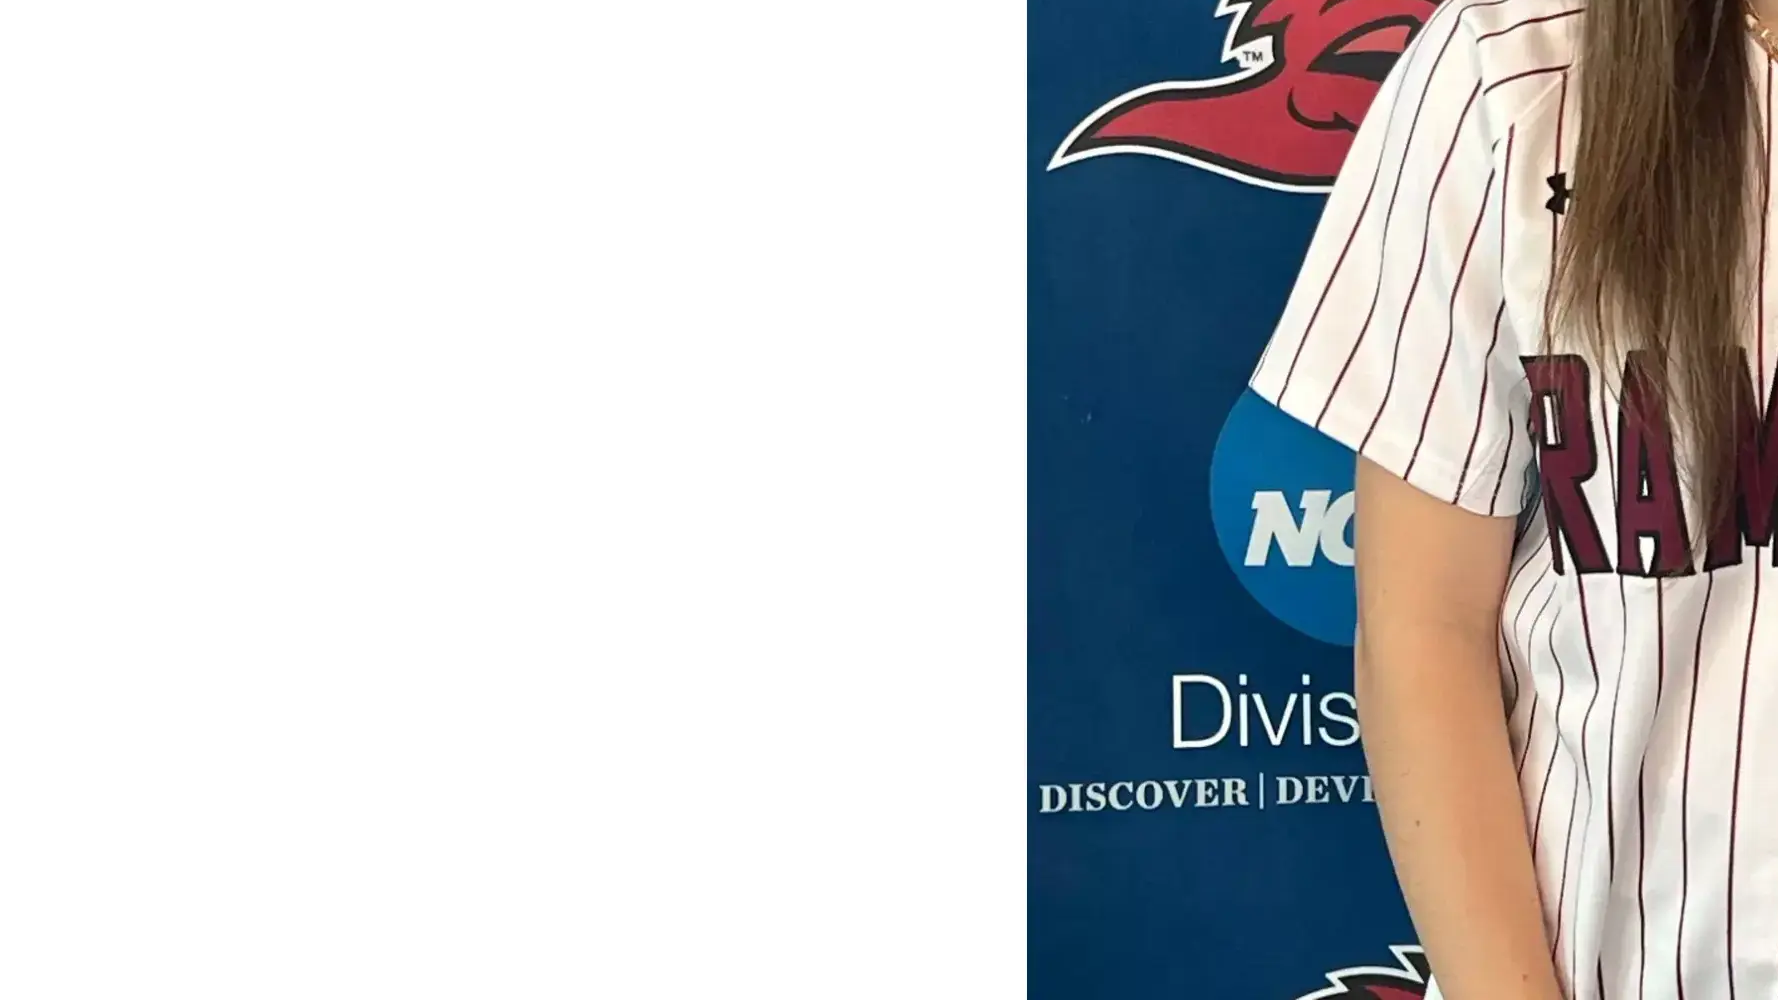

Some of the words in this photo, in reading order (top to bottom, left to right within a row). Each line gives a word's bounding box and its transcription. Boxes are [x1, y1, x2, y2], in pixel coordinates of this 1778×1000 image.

[1243, 50, 1264, 62] TM
[1171, 673, 1361, 748] Divis
[1039, 778, 1250, 814] DISCOVER
